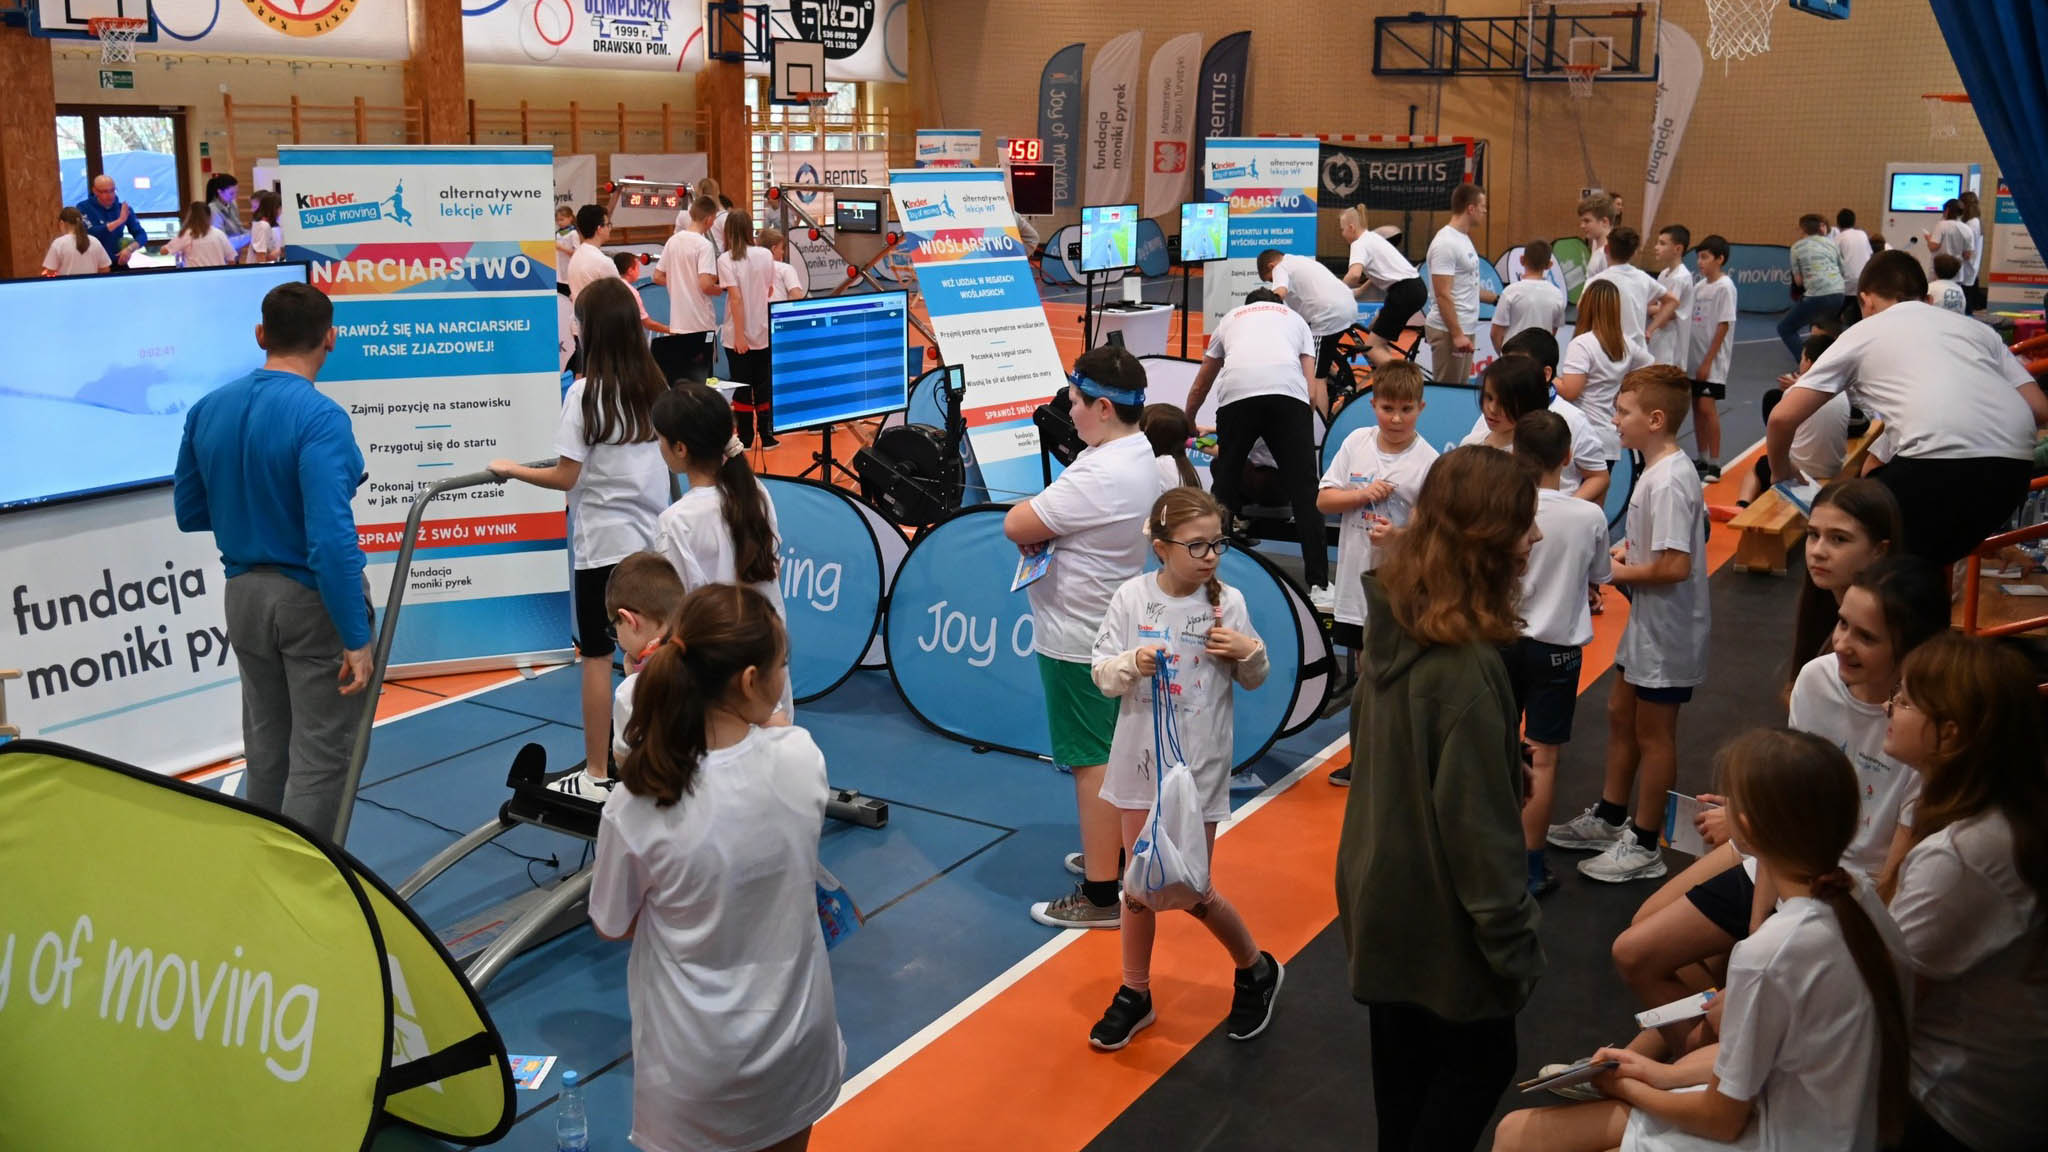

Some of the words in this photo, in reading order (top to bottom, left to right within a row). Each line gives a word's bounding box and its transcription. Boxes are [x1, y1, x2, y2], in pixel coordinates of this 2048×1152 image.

[615, 26, 639, 37] 1999
[593, 40, 642, 54] DRAWSKO
[646, 43, 671, 56] POM.
[1048, 89, 1068, 120] Joy
[1113, 83, 1128, 123] pyrek
[1052, 124, 1068, 140] of
[1093, 112, 1108, 170] fundacja
[1112, 127, 1124, 170] moniki
[1646, 118, 1674, 185] fundacja
[440, 186, 542, 202] alternatywne
[630, 195, 641, 206] 20
[650, 196, 658, 206] 14
[666, 196, 676, 206] 45
[304, 212, 324, 225] Joy
[326, 210, 336, 222] of
[340, 207, 377, 220] moving
[440, 202, 484, 220] lekcje
[490, 203, 513, 216] WF
[854, 210, 864, 219] 11
[918, 236, 1013, 256] WIOŚLARSTWO
[312, 255, 531, 284] NARCIARSTWO
[1738, 265, 1792, 286] moving
[393, 323, 412, 338] SIĘ
[416, 322, 435, 334] NA
[439, 320, 531, 333] NARCIARSKIEJ
[362, 344, 408, 357] TRASIE
[412, 340, 495, 355] ZJAZDOWEJ!
[352, 404, 385, 416] Zajmij
[388, 402, 430, 415] pozycję
[433, 402, 446, 410] na
[450, 398, 511, 410] stanowisku
[370, 440, 424, 454] Przygotuj
[427, 439, 443, 452] się
[446, 439, 460, 448] do
[464, 438, 497, 448] startu
[370, 480, 414, 492] Pokonaj
[368, 498, 377, 506] w
[380, 494, 398, 508] jak
[470, 488, 504, 499] czasie
[359, 526, 427, 546] SPRAWŹ
[432, 524, 469, 540] SWÓJ
[474, 522, 518, 537] WYNIK
[410, 566, 452, 578] fundacja
[412, 578, 442, 590] moniki
[446, 576, 472, 590] pyrek
[13, 560, 207, 636] fundacja
[918, 600, 998, 668] Joy
[1012, 613, 1035, 657] o
[26, 624, 173, 700] moniki
[28, 914, 94, 1009] of
[100, 938, 320, 1083] moving
